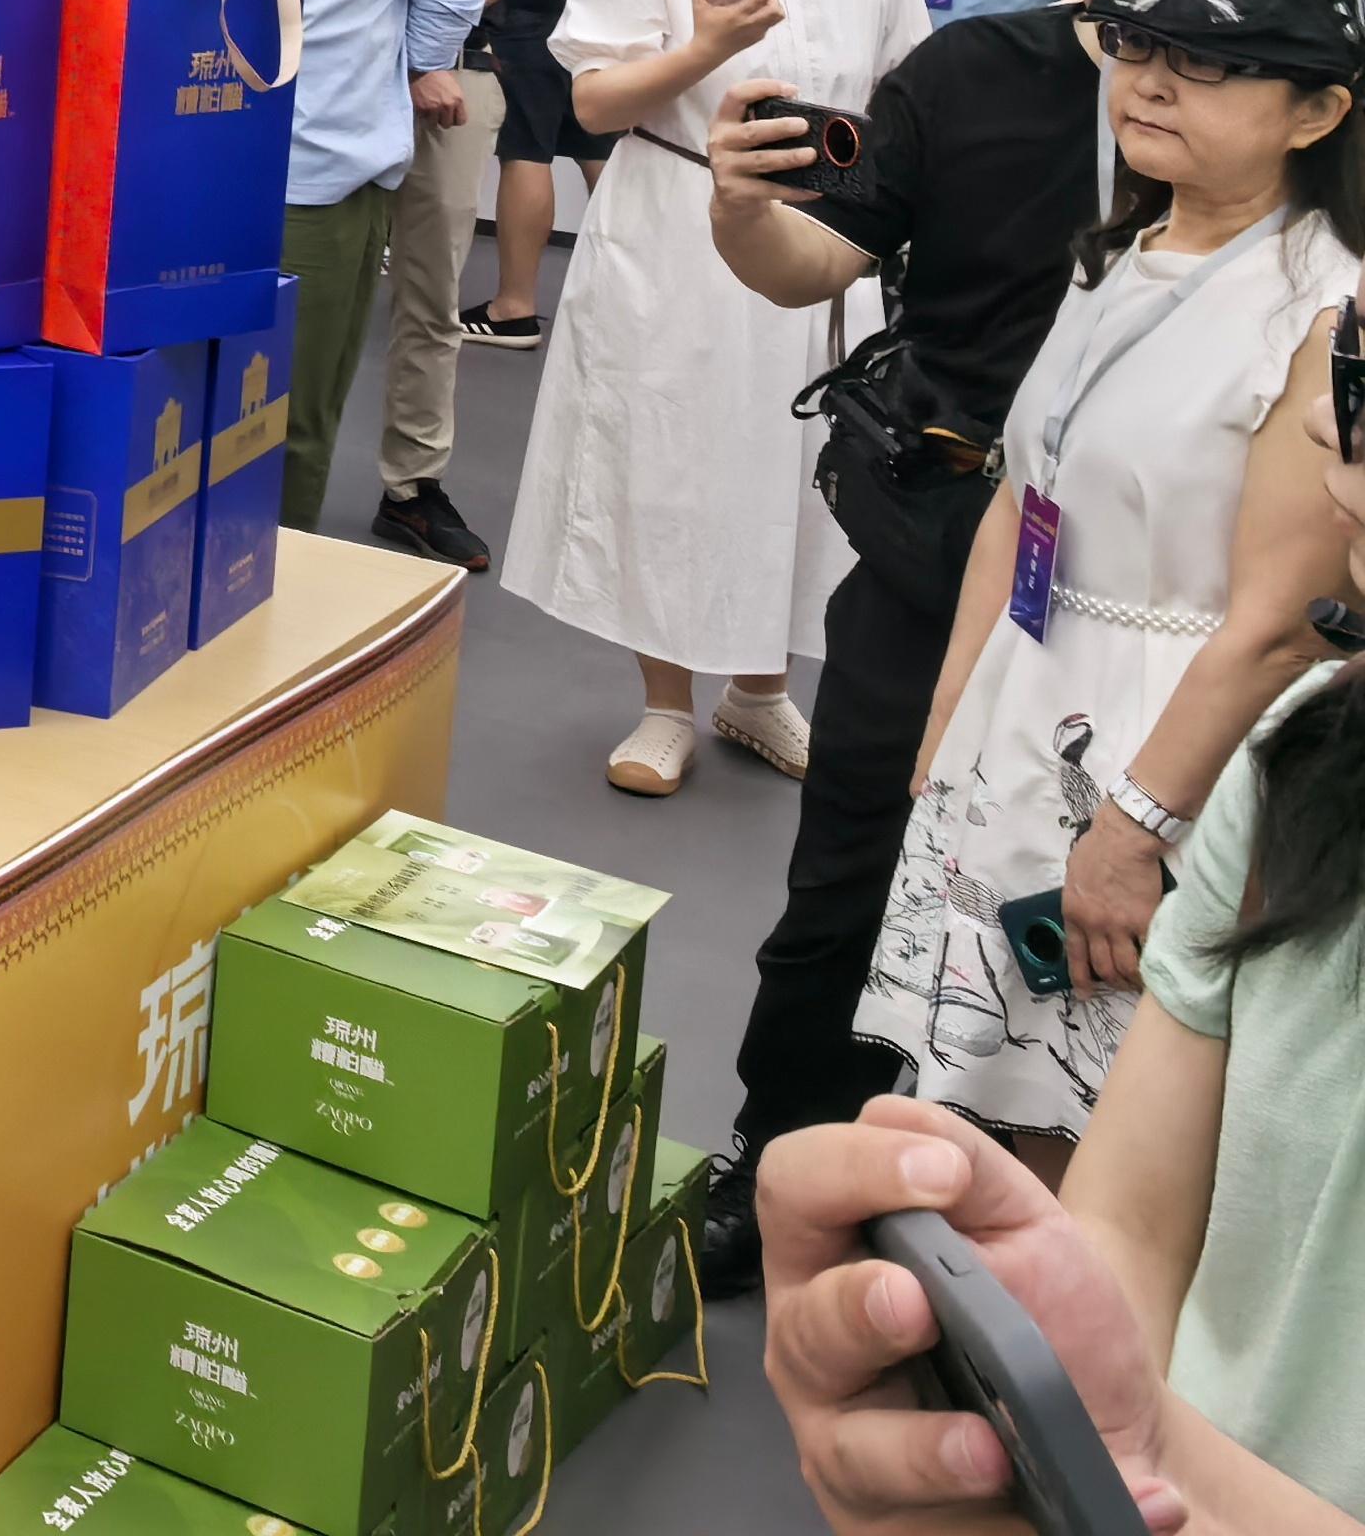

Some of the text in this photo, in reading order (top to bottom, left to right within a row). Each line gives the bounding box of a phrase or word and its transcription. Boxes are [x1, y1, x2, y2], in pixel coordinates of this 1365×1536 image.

[324, 1015, 378, 1053] 琼州
[310, 1038, 386, 1083] 糟粕醋
[183, 1320, 239, 1364] 琼州
[169, 1343, 249, 1396] 糟粕醋
